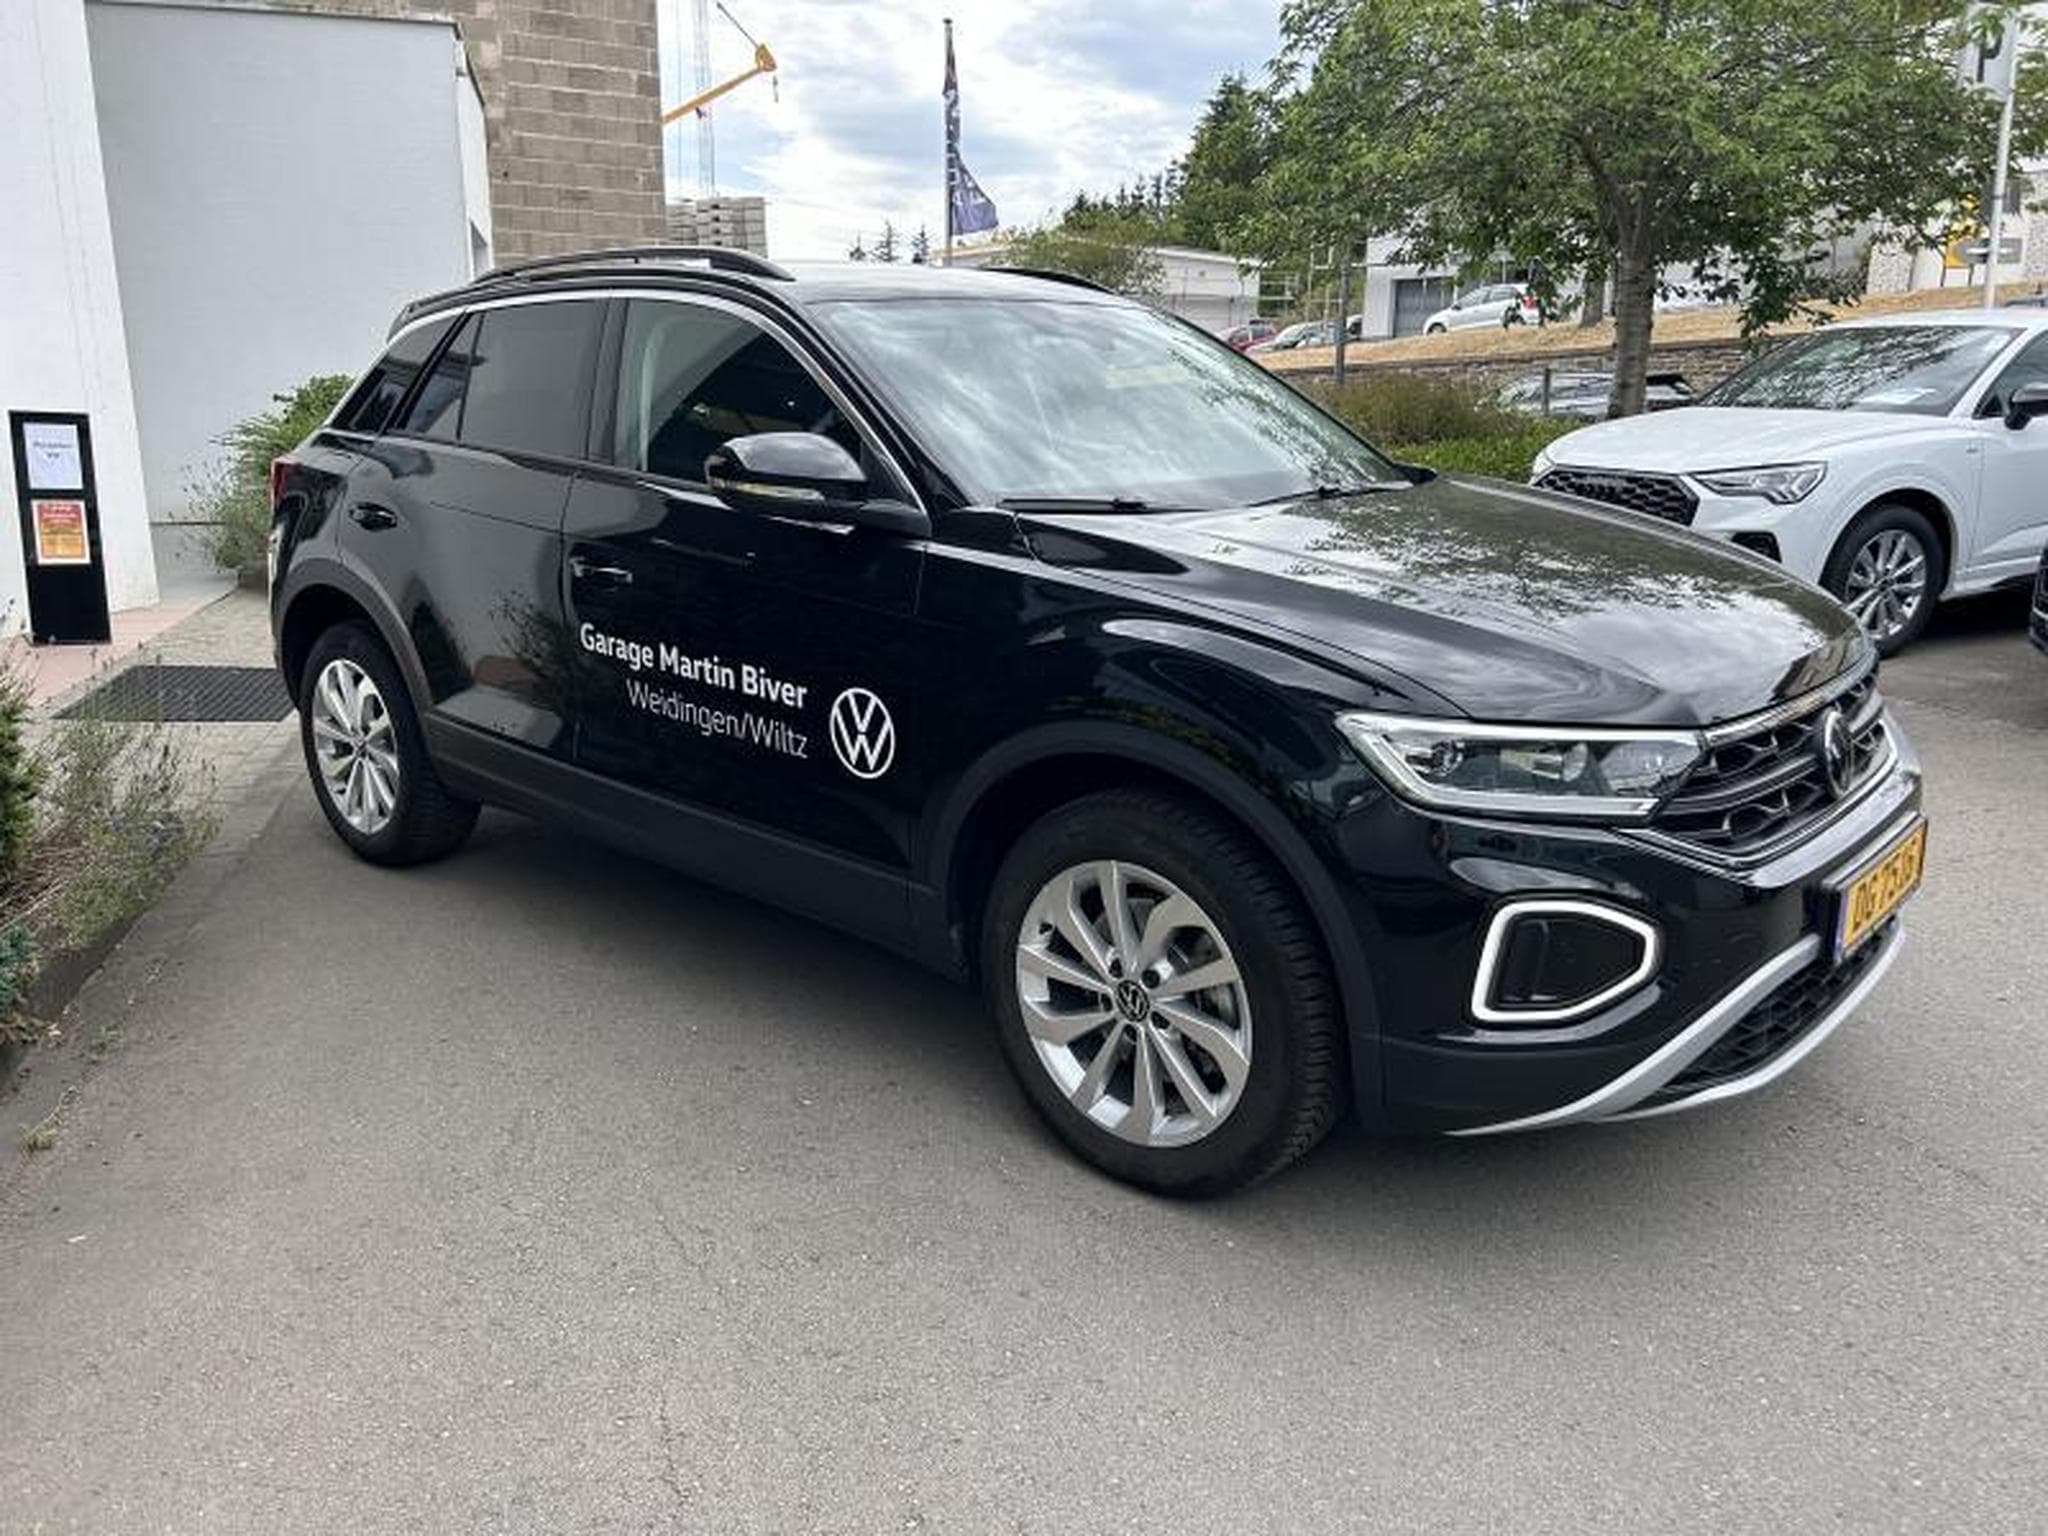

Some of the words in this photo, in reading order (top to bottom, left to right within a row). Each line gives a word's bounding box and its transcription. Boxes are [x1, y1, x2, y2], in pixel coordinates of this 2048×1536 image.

[580, 622, 653, 671] Garage
[660, 642, 735, 690] Martin
[741, 665, 808, 708] Biver
[625, 678, 808, 759] Weidingen/Wiltz
[829, 687, 896, 779] VW
